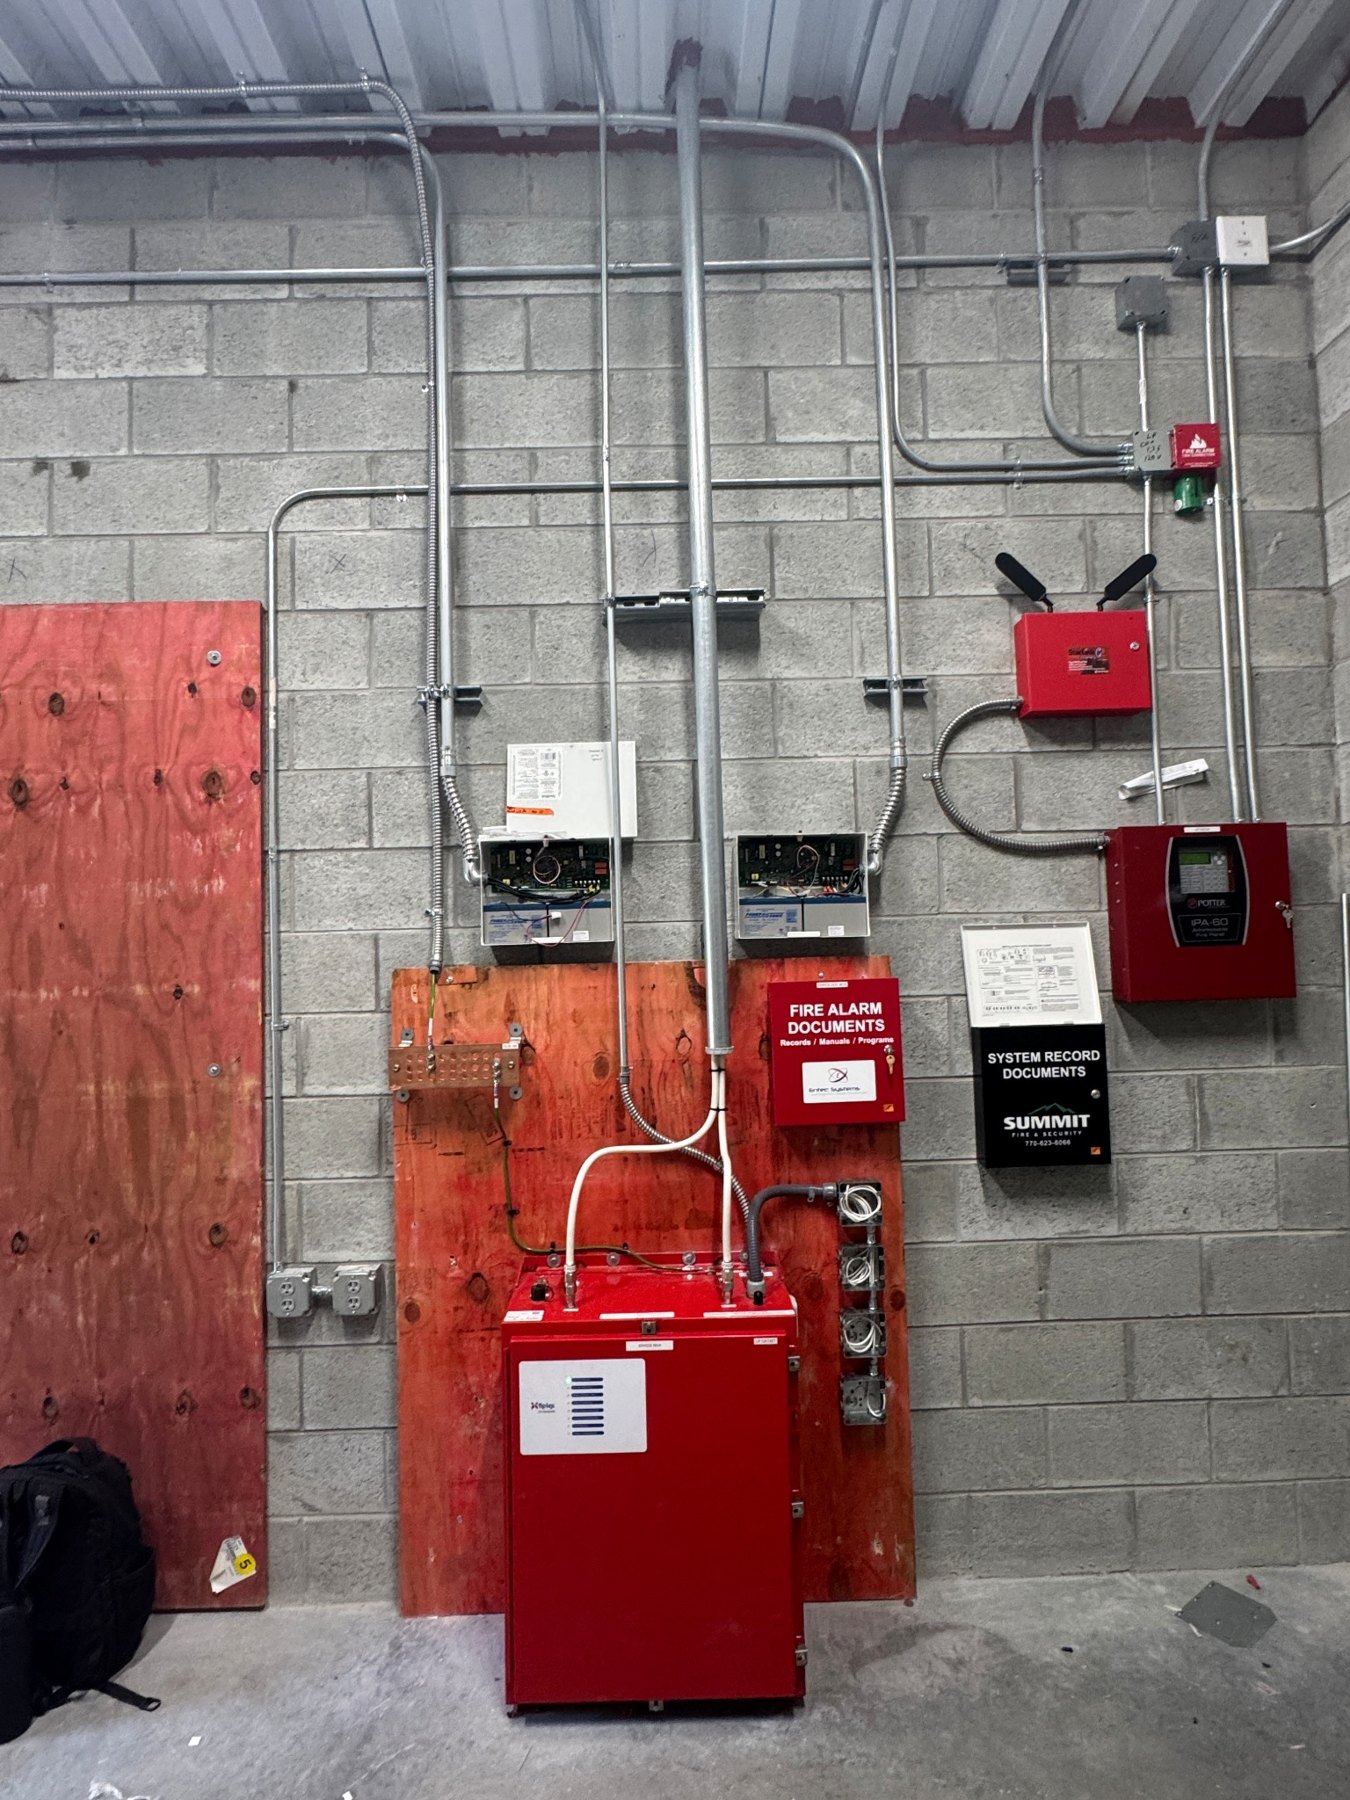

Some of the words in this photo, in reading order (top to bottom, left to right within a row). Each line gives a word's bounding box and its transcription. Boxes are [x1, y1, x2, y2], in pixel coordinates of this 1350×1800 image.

[1197, 899, 1227, 907] POTTER
[1191, 917, 1229, 927] IPA-60
[789, 1004, 824, 1018] FIRE
[827, 1002, 882, 1016] ALARM
[787, 1019, 885, 1034] DOCUMENTS
[780, 1039, 811, 1047] Records
[819, 1038, 850, 1046] Manuals
[858, 1036, 895, 1044] Programs
[988, 1052, 1041, 1064] SYSTEM
[1044, 1050, 1100, 1062] RECORD
[1003, 1066, 1086, 1079] DOCUMENTS
[1003, 1114, 1090, 1130] SUMMIT
[239, 1559, 251, 1569] 5
